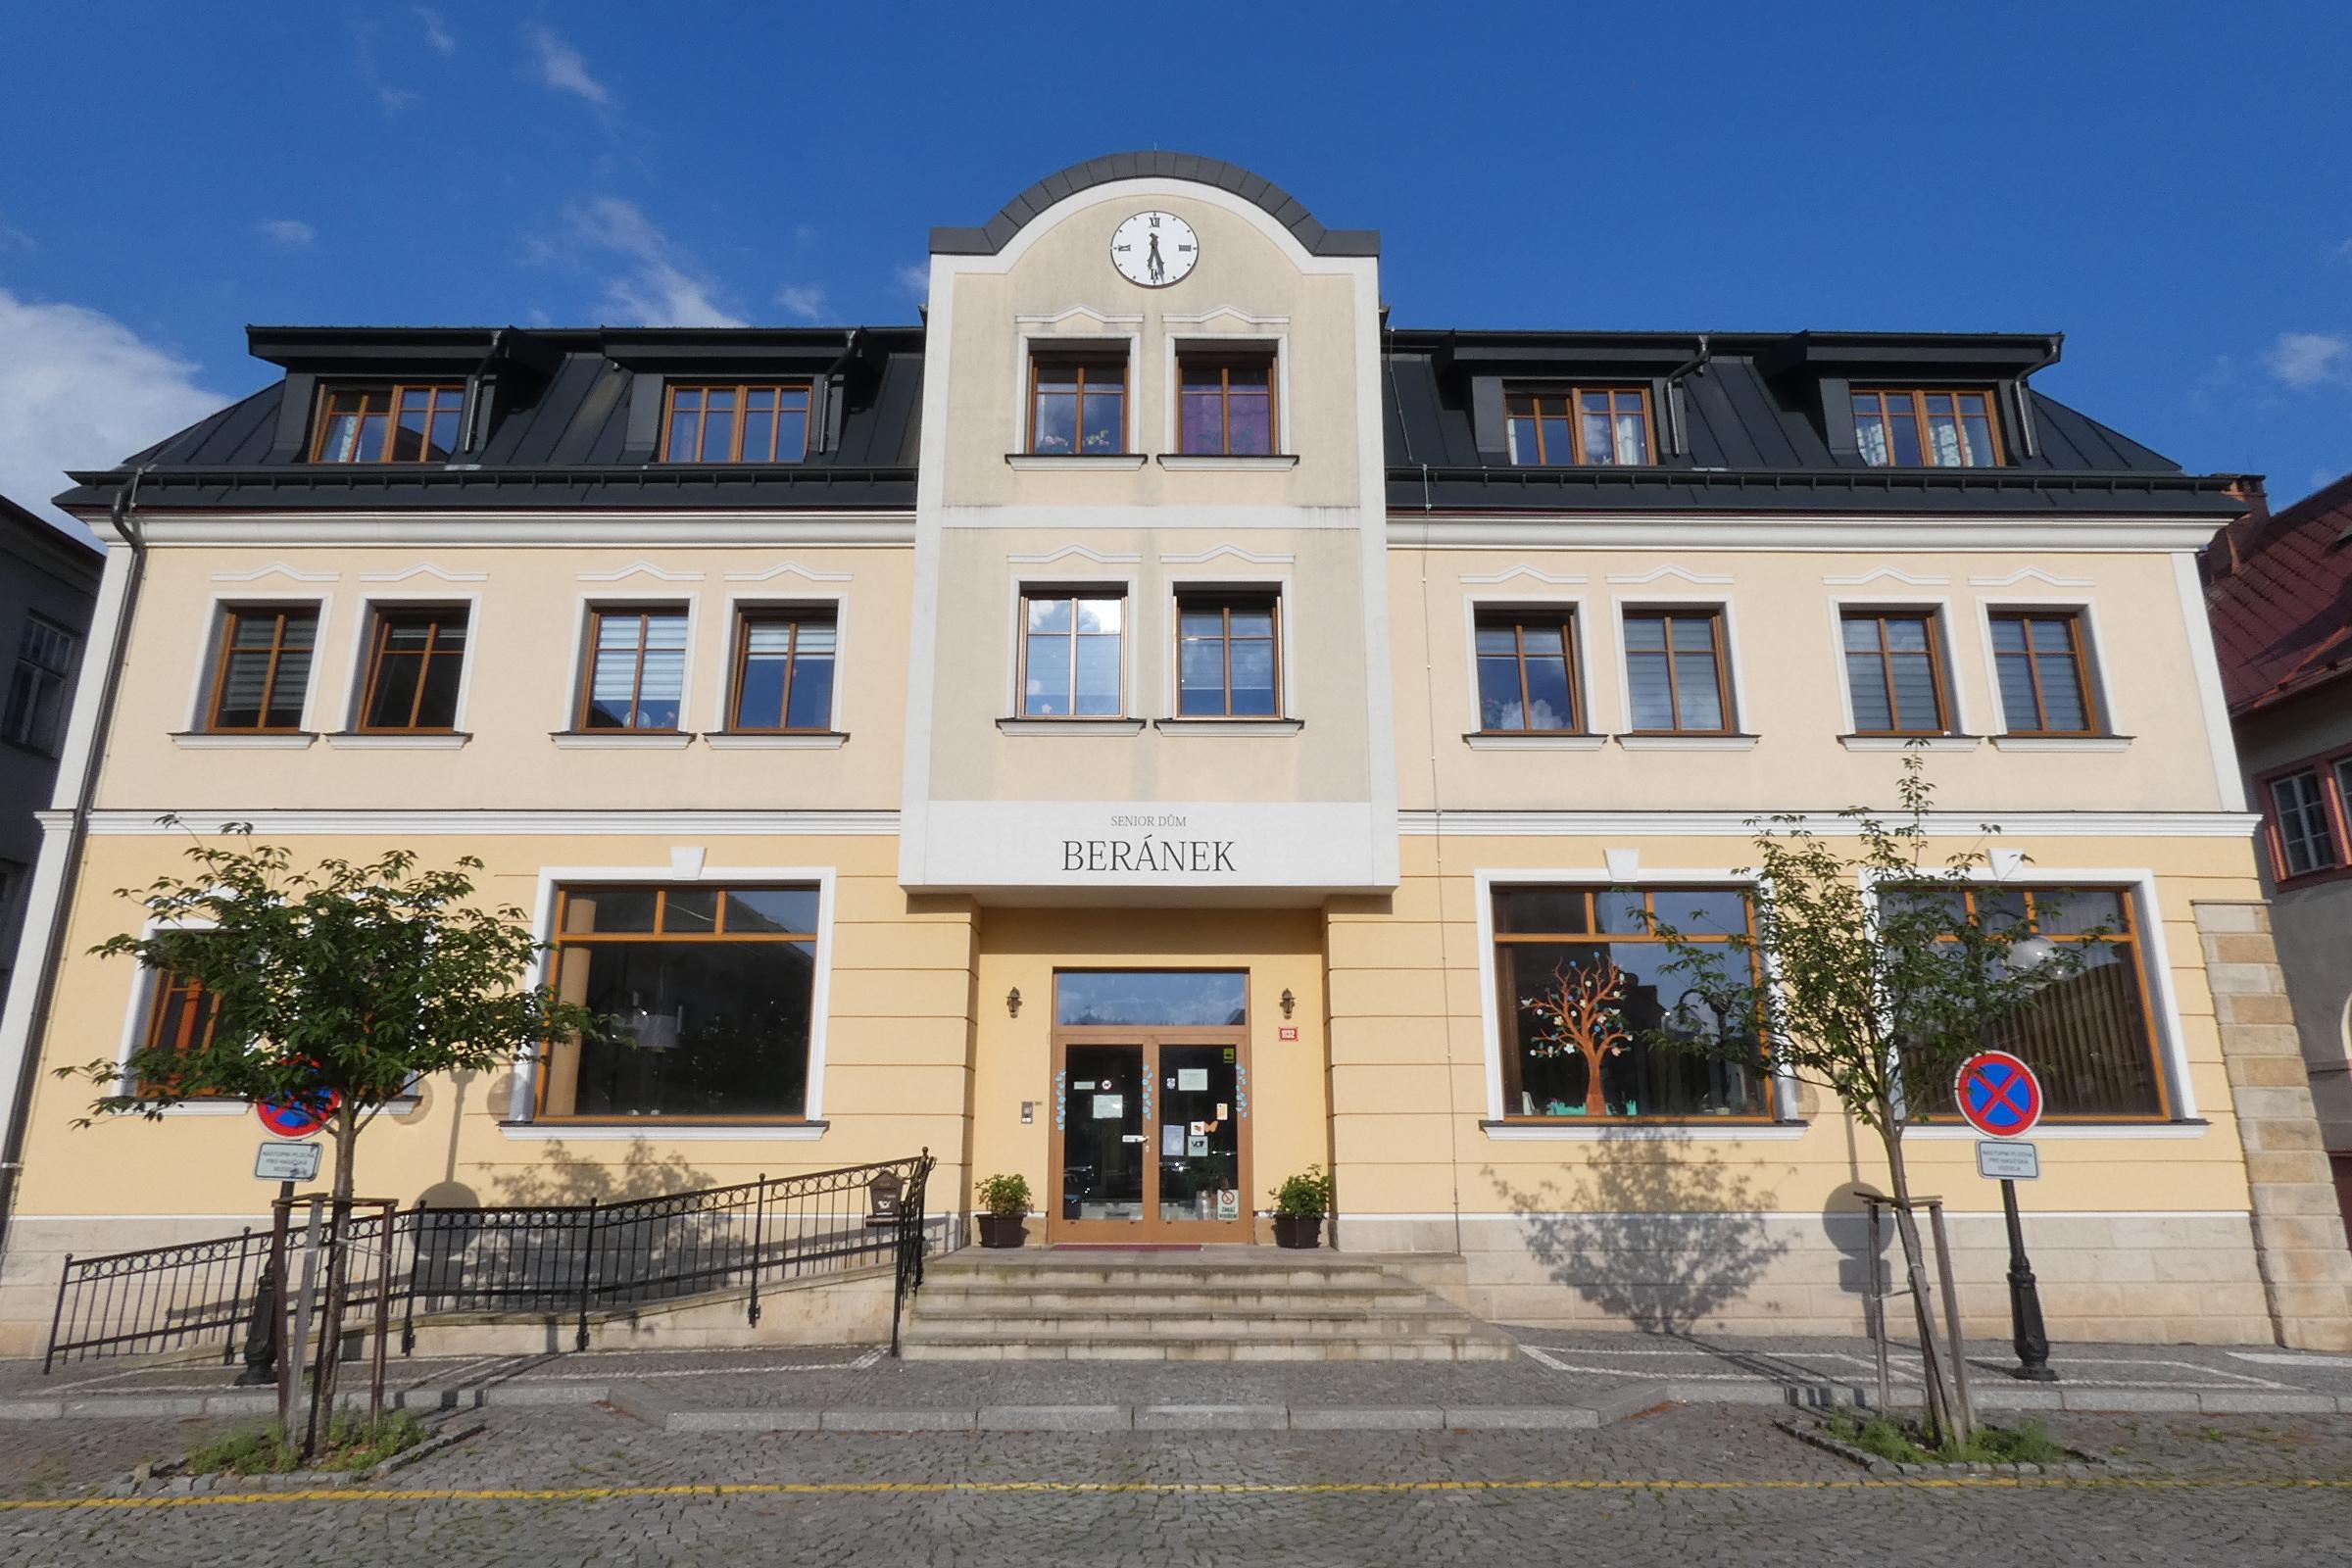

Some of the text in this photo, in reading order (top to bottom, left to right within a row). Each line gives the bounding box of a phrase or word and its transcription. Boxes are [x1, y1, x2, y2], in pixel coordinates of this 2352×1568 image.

[1110, 813, 1186, 826] SENIOR DŮM
[1061, 834, 1237, 871] BERÁNEK
